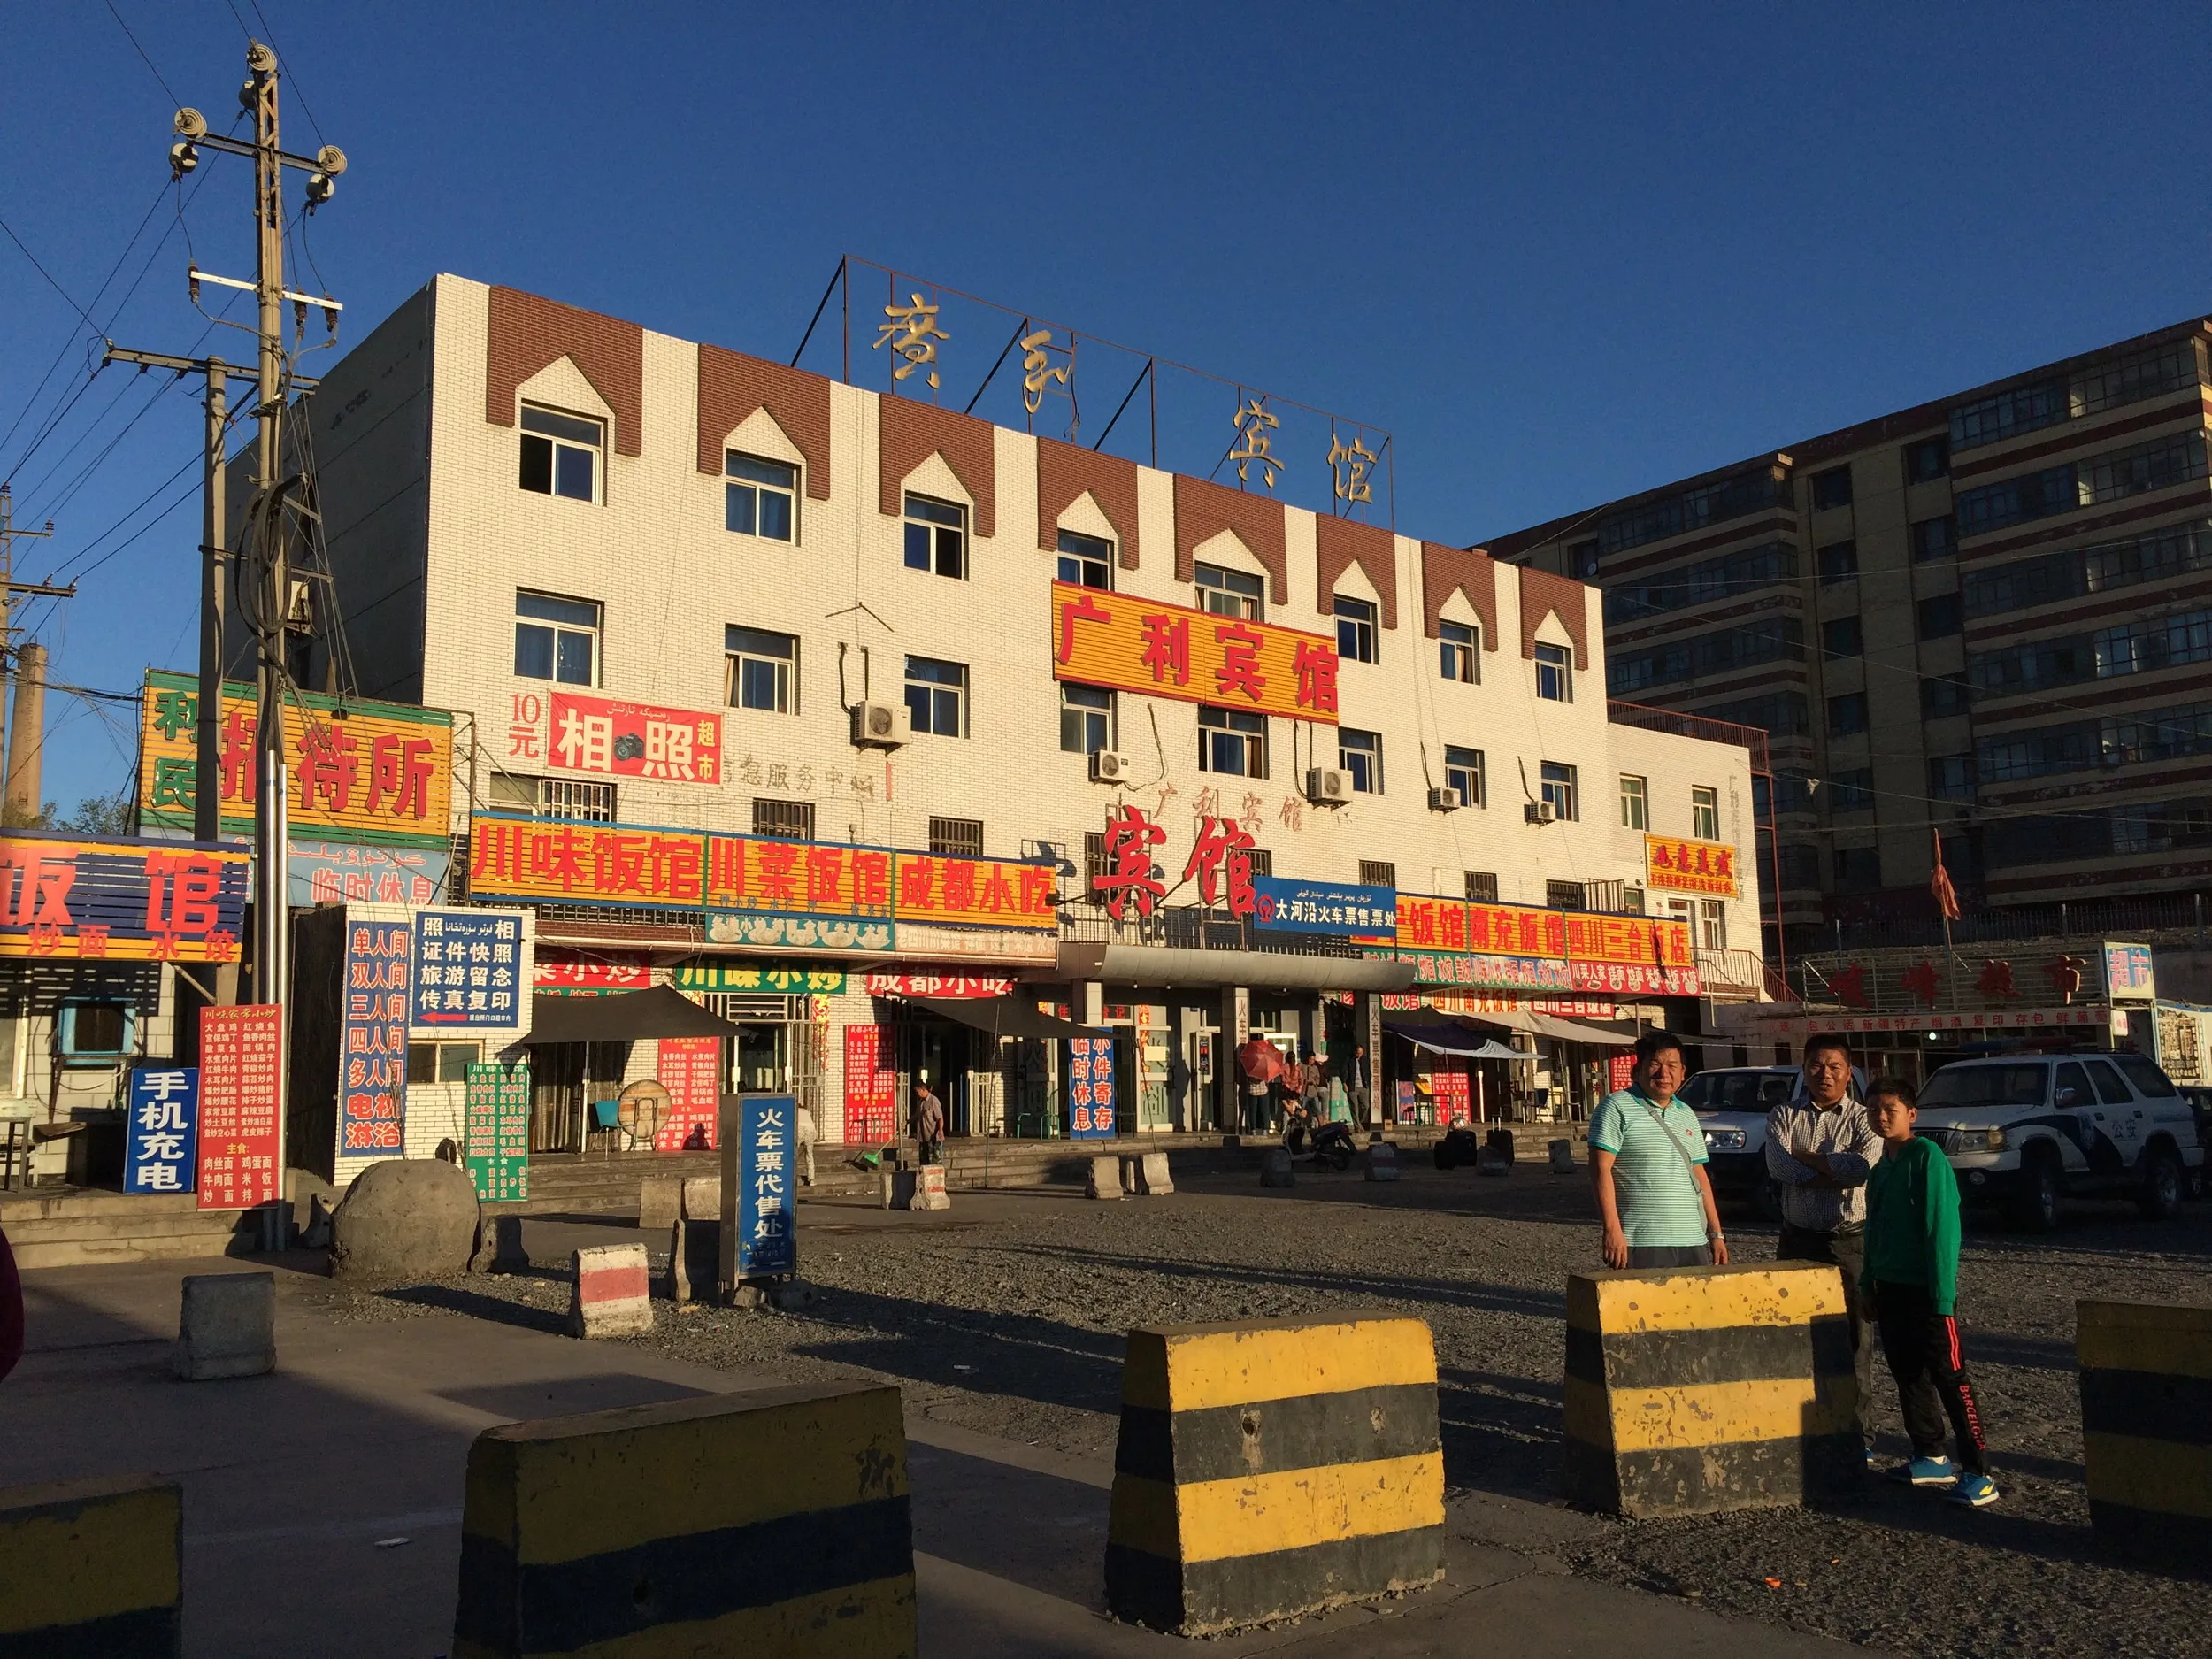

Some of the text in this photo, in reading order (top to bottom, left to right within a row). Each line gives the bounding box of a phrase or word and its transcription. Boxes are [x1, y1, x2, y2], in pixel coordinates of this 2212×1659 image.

[1057, 595, 1340, 713] 广利宾馆
[510, 693, 541, 724] 10
[509, 726, 539, 758] 元
[557, 708, 695, 780] 相 照
[697, 719, 715, 780] 超市
[471, 825, 702, 898] 川味饭馆
[707, 837, 888, 904] 川菜饭馆
[1094, 804, 1257, 920] 宾馆
[0, 842, 222, 934] 饭馆
[312, 867, 435, 905] 临时休息
[900, 856, 1054, 915] 成都小吃
[423, 917, 443, 936] 照
[495, 919, 515, 940] 相
[1275, 898, 1396, 928] 大河沿火车票售票处
[27, 922, 235, 962] 炒面 水饺
[351, 928, 409, 958] 单人间
[1470, 907, 1564, 955] 南充饭馆
[421, 941, 513, 963] 证件快照
[350, 962, 407, 990] 双人间
[420, 965, 512, 987] 旅游留念
[680, 961, 843, 990] 川味小炒
[869, 966, 1008, 995] 成都小吃
[2109, 949, 2149, 993] 超市
[349, 995, 406, 1022] 三人间
[419, 989, 511, 1010] 传真复印
[1433, 987, 1517, 1013] 四川南充饭馆
[1862, 1018, 1922, 1030] 新疆特产
[1973, 1014, 2004, 1027] 复印
[2015, 1012, 2045, 1025] 存包
[2055, 1011, 2108, 1025] 鲜葡萄
[349, 1026, 404, 1054] 四人间
[348, 1058, 403, 1087] 多人间
[1071, 1038, 1091, 1131] 临时休息
[1093, 1038, 1113, 1131] 小件寄存
[137, 1071, 189, 1190] 手机充电
[345, 1121, 400, 1148] 淋浴
[204, 1156, 273, 1170] 肉丝面 鸡蛋面
[754, 1108, 785, 1240] 火车票代售处
[204, 1173, 234, 1187] 牛肉面
